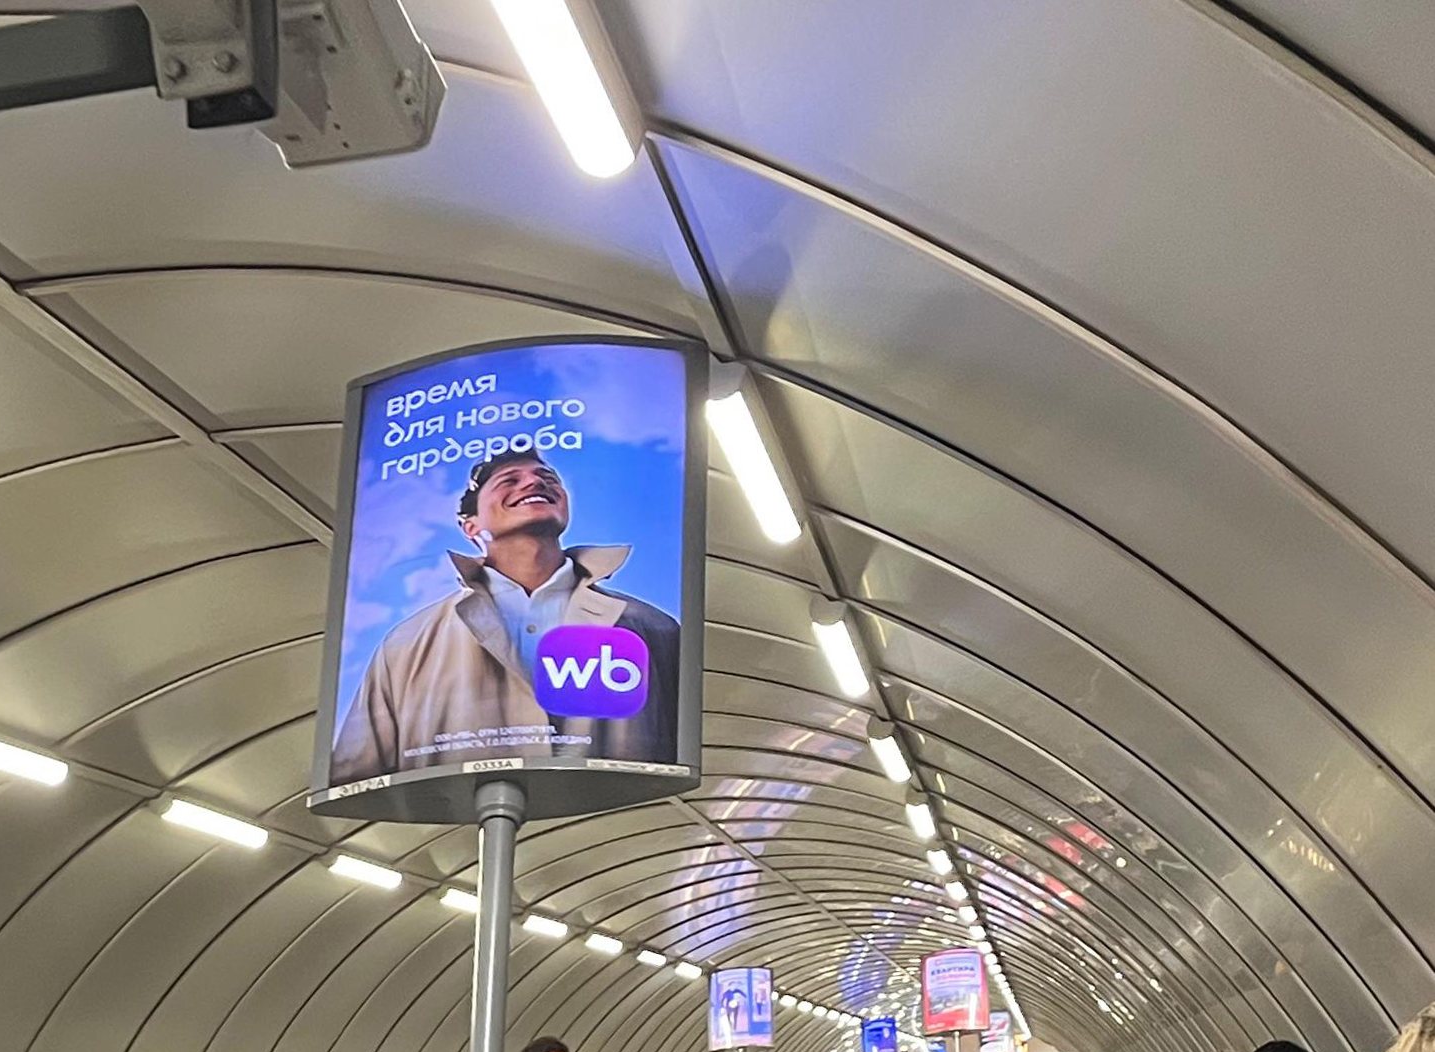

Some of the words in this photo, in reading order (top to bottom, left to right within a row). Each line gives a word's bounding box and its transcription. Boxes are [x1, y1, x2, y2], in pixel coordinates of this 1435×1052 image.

[386, 374, 497, 417] время
[383, 415, 445, 447] для
[456, 399, 586, 429] нового
[381, 424, 583, 480] гардероба
[542, 645, 642, 692] wb
